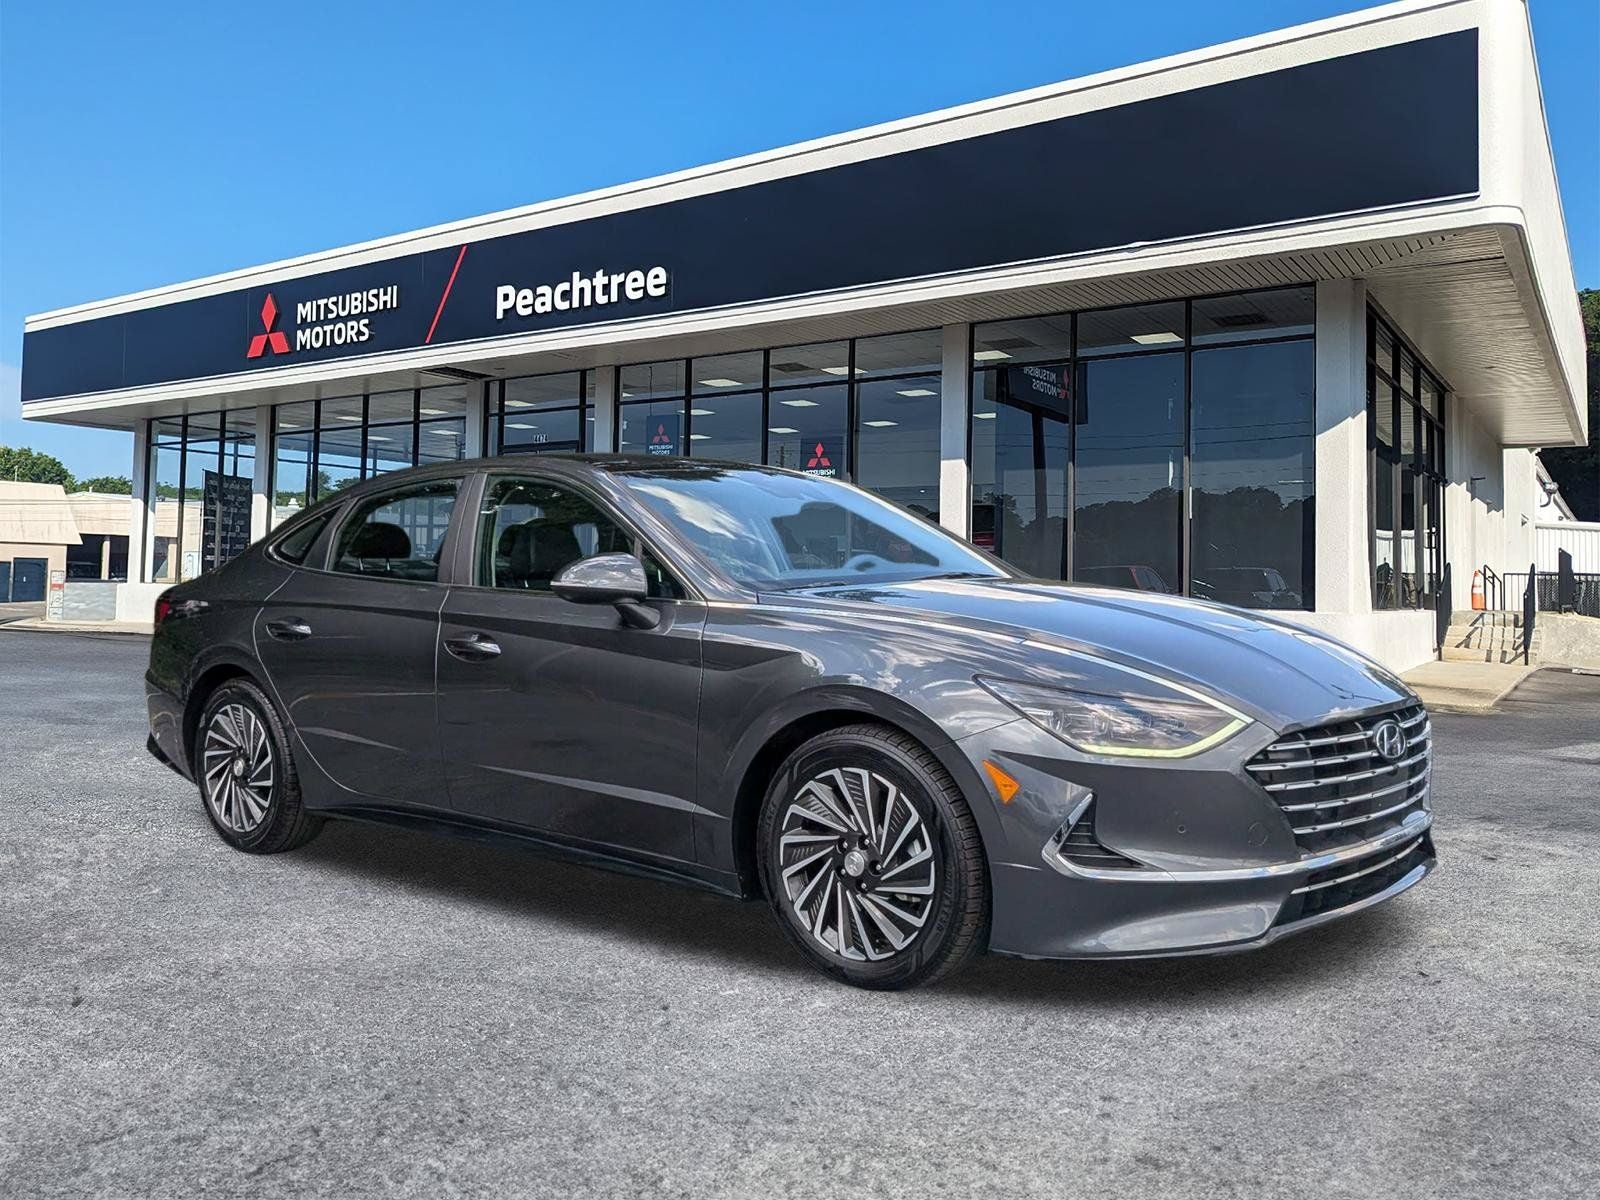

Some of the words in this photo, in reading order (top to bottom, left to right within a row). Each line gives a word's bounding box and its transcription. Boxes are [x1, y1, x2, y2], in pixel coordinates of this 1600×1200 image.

[296, 285, 398, 324] MITSUBISHI
[496, 266, 667, 320] Peachtree
[296, 319, 370, 351] MOTORS
